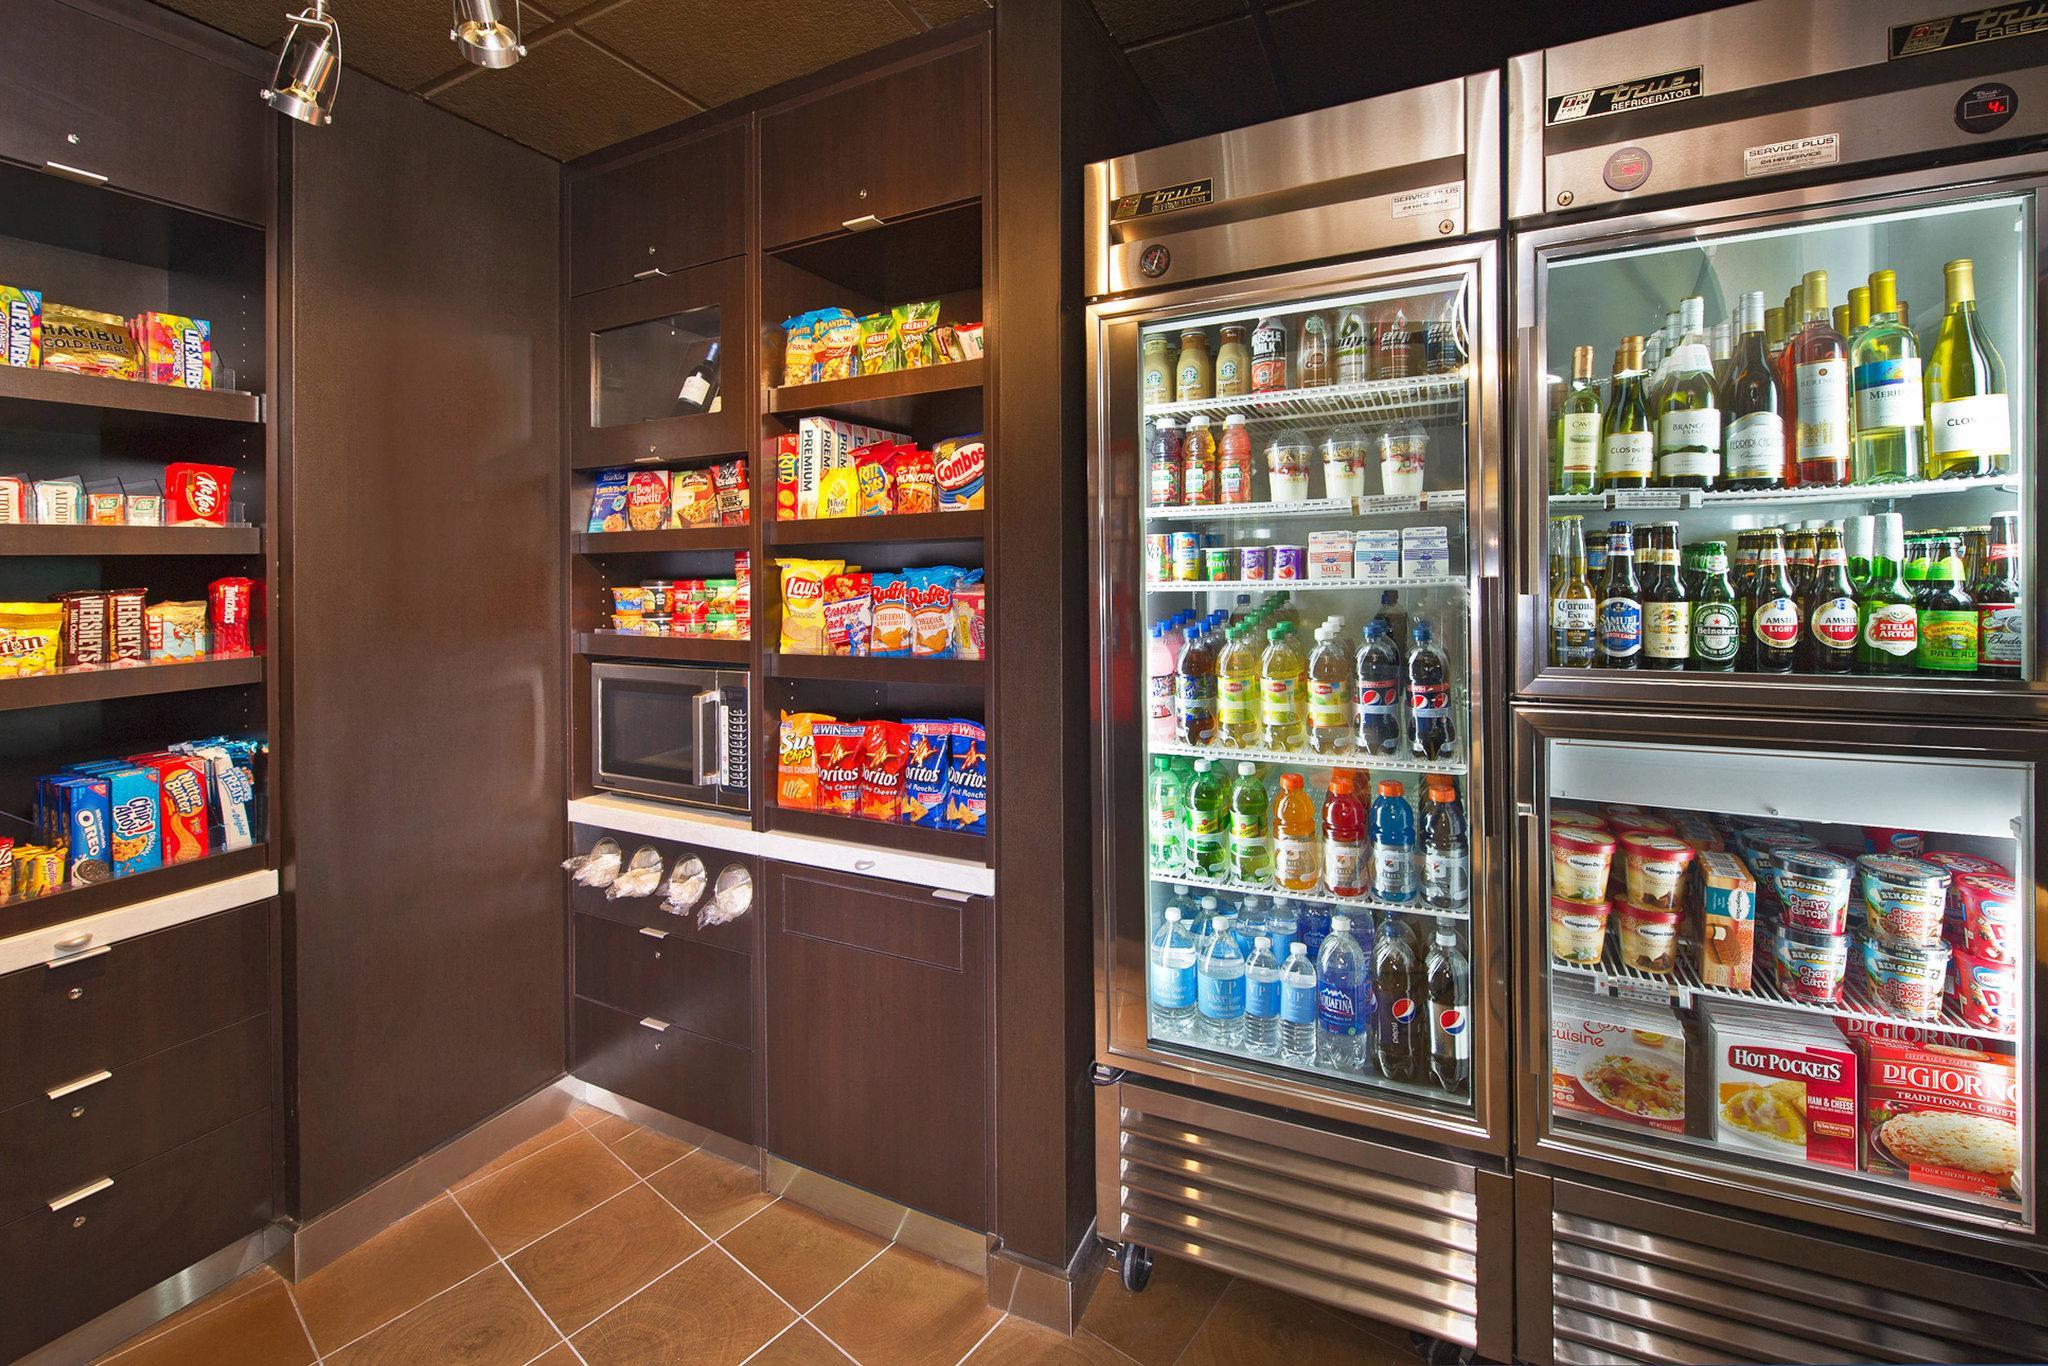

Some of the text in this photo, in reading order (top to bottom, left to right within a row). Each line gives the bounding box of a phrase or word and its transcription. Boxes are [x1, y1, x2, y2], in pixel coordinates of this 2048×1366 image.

[1961, 3, 2048, 30] tru
[1976, 19, 2048, 41] FREEZ
[1611, 88, 1691, 111] REFRIGERATOR
[1749, 137, 1834, 157] SERVICE PLUS
[1786, 151, 1822, 161] SERVICE
[1572, 420, 1592, 428] CAVI
[1672, 422, 1714, 431] BRANCO
[823, 430, 832, 469] PREM
[840, 433, 848, 467] PREM
[1610, 446, 1631, 455] CLOS
[803, 429, 814, 492] PREMIUM
[937, 447, 985, 483] Combos
[1, 485, 10, 523] ALTOID
[55, 489, 68, 524] ALTOID
[1321, 565, 1342, 574] MILK
[871, 581, 906, 605] Ruffl
[824, 603, 864, 618] Cracker
[1557, 600, 1595, 612] Corona
[1567, 611, 1589, 619] Extra
[1600, 614, 1639, 626] SAMUEL
[1601, 623, 1637, 633] ADAMS
[1696, 626, 1737, 635] Heineken
[1878, 630, 1915, 639] ARTOIS
[1879, 623, 1914, 631] STELLA
[1930, 650, 1959, 658] PALE
[820, 725, 841, 735] WIN
[905, 766, 941, 783] oritos
[178, 770, 204, 807] Nutter
[218, 770, 244, 805] TREATS
[873, 786, 898, 796] Cheese
[163, 779, 193, 814] Butter
[127, 796, 152, 828] Chips
[77, 810, 101, 857] OREO
[1790, 895, 1829, 911] Cherry
[1791, 905, 1828, 920] Garcia
[1391, 1021, 1400, 1044] pepsi
[1733, 1049, 1843, 1083] HOT POCKETS
[1807, 1095, 1854, 1112] HAM & CHEESE
[1896, 1091, 2017, 1118] TRADITIONAL CRUST
[1920, 1166, 1986, 1184] FOUR CHEESE PIZZA
